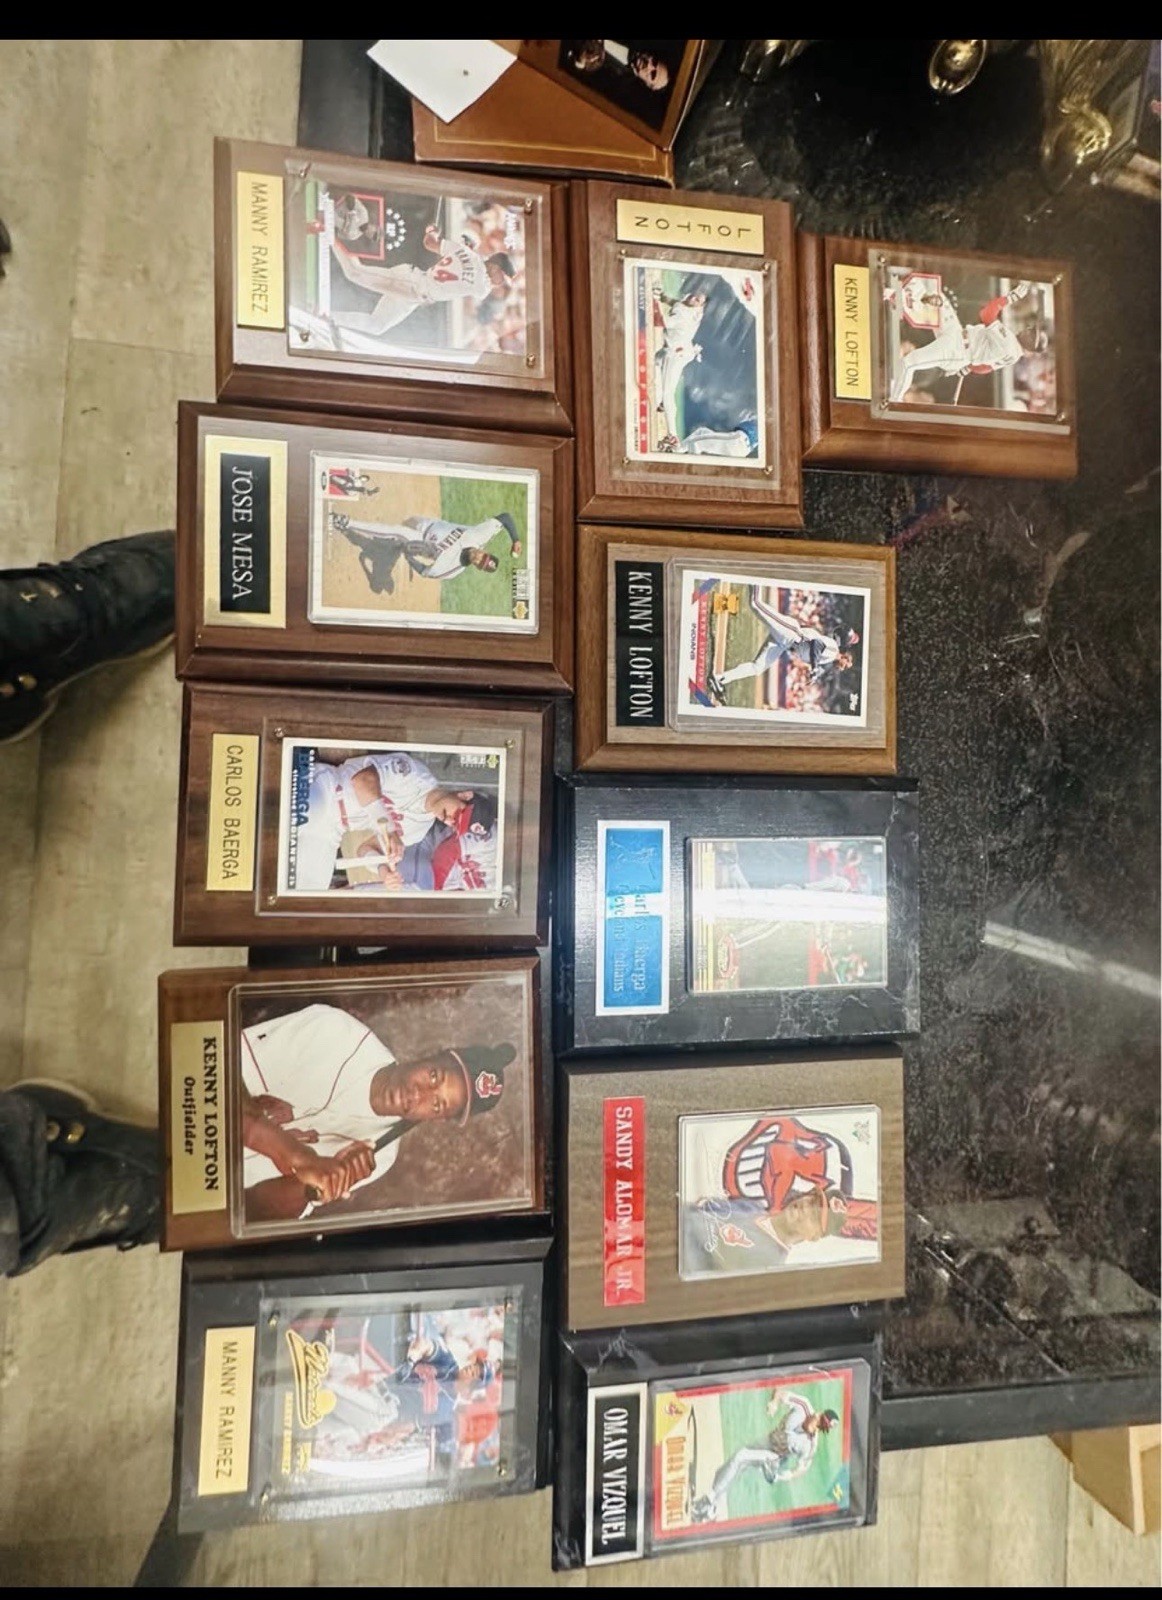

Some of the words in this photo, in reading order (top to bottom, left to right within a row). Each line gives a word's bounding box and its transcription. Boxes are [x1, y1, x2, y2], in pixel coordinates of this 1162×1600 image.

[251, 182, 268, 236] MANNY
[250, 245, 269, 314] RAMIREZ
[844, 277, 858, 323] KENNY
[845, 331, 859, 387] LOFTON
[231, 466, 254, 522] JOSE
[232, 532, 254, 600] MESA
[628, 571, 654, 634] KENNY
[628, 646, 654, 718] LOFTON
[224, 744, 244, 807] CARLOS
[297, 752, 310, 827] BAERGA
[222, 818, 242, 880] BAERGA
[204, 1036, 218, 1107] KENNY
[183, 1076, 196, 1156] Outfielder
[615, 1106, 632, 1170] SANDY
[204, 1113, 219, 1190] LOFTON
[616, 1180, 634, 1257] ALOMAR
[220, 1341, 239, 1396] MANNY
[214, 1406, 236, 1478] RAMIREZ
[602, 1408, 628, 1462] OMAR
[600, 1466, 628, 1546] VIZQUEL
